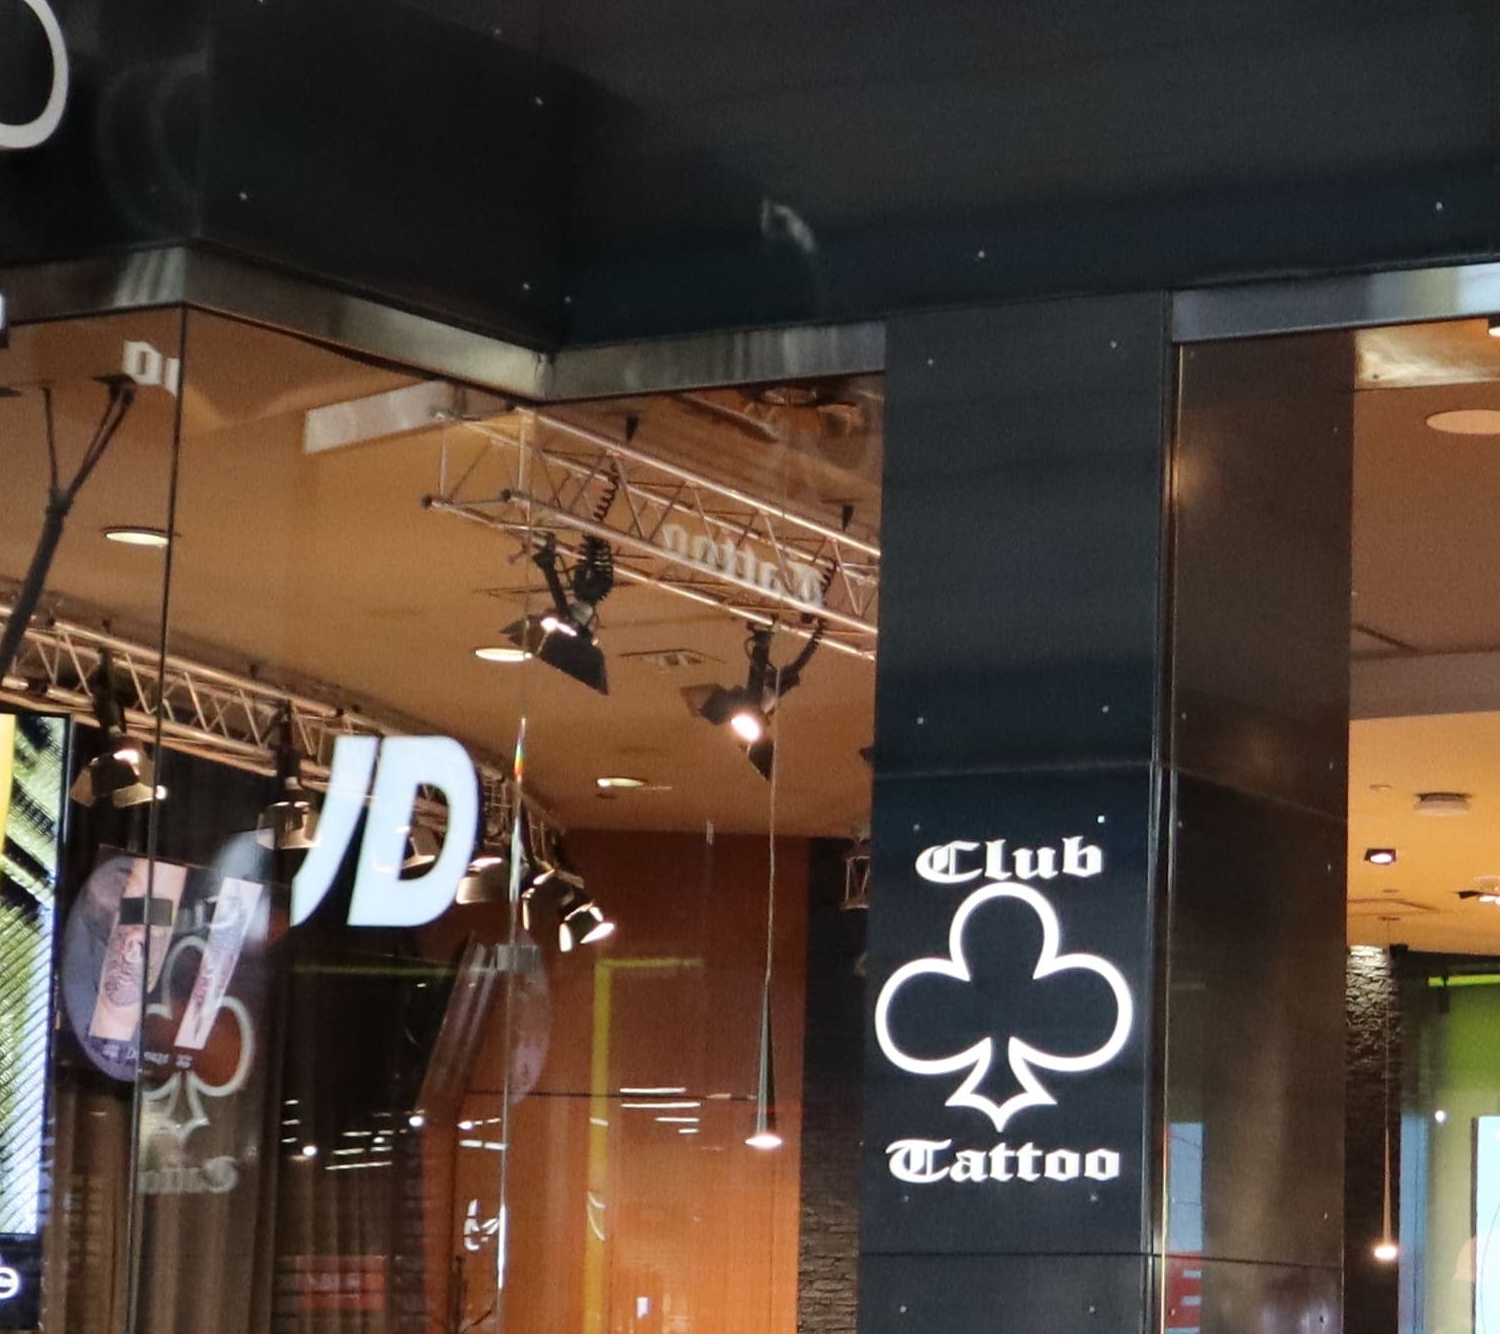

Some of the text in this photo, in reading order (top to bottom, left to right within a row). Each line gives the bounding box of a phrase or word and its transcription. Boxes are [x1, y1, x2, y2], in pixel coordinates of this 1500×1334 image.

[291, 734, 478, 927] JD
[915, 835, 1104, 884] Club
[885, 1138, 1121, 1184] Tattoo
